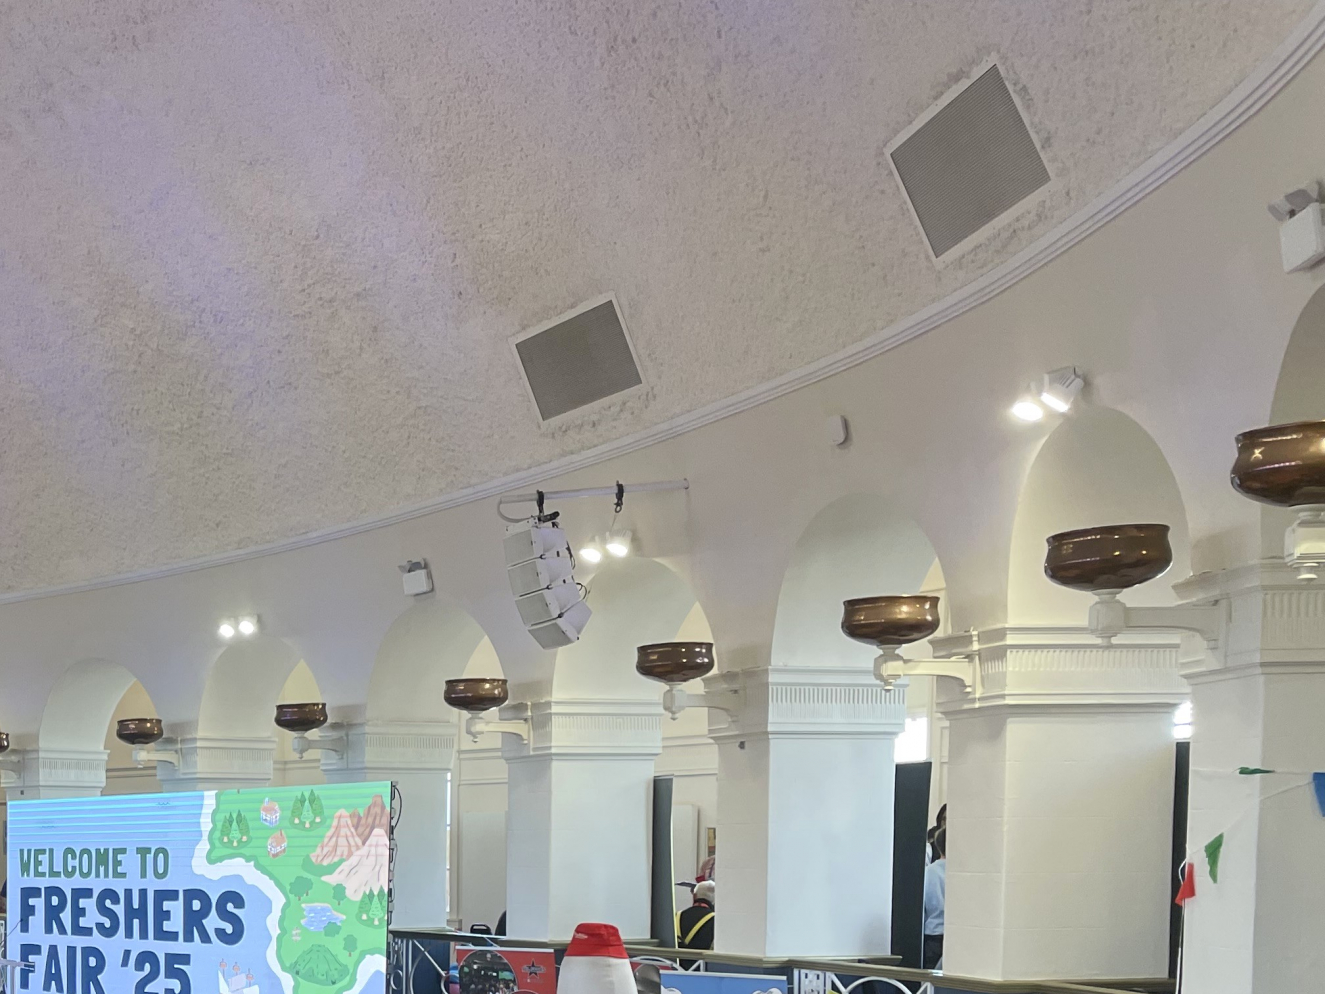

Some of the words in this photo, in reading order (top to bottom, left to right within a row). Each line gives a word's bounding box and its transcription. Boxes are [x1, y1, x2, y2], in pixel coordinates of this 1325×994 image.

[19, 847, 127, 878] WELCOME
[136, 847, 169, 880] TO
[20, 886, 246, 946] FRESHERS
